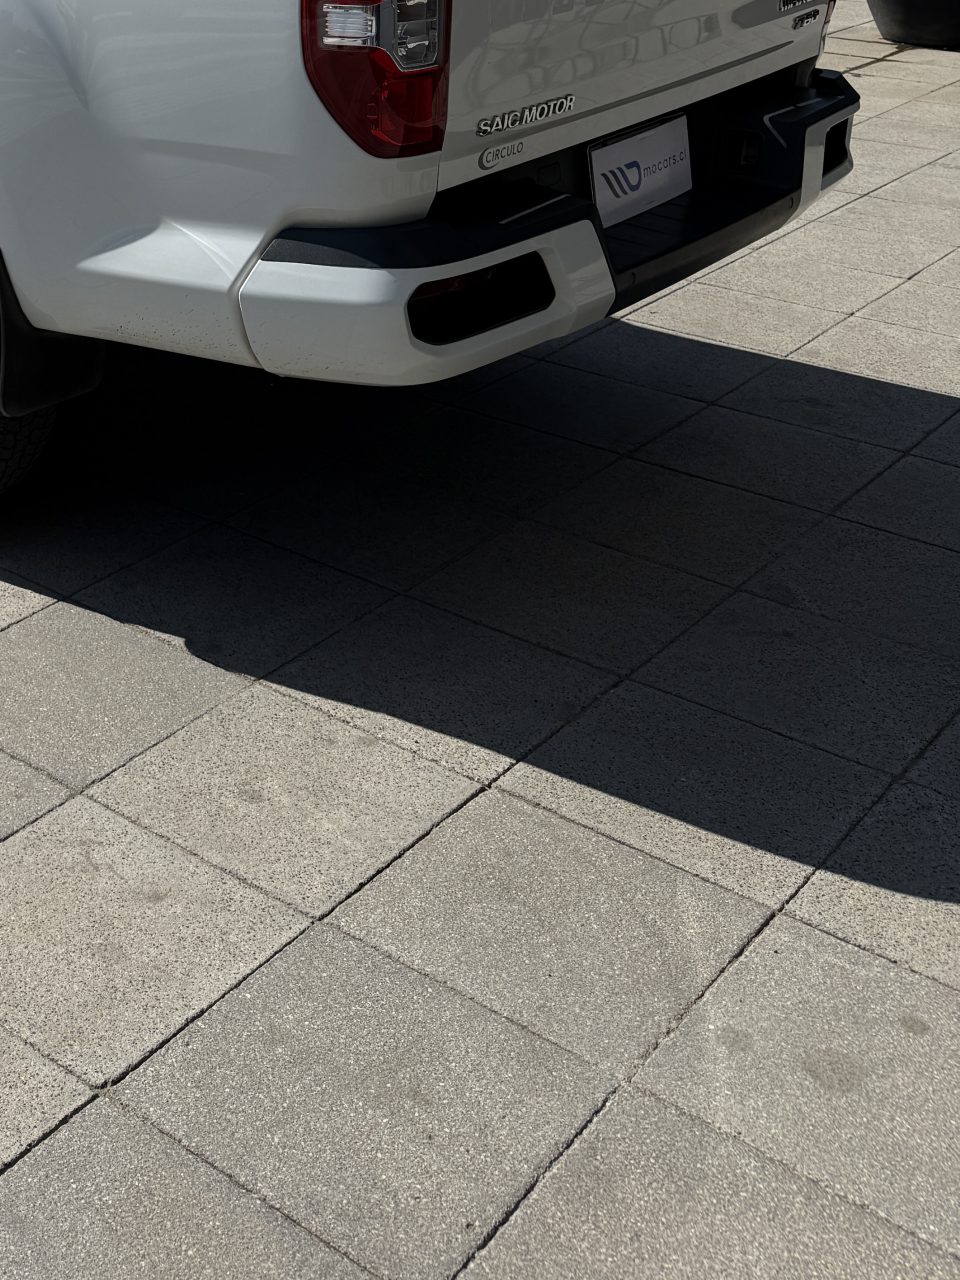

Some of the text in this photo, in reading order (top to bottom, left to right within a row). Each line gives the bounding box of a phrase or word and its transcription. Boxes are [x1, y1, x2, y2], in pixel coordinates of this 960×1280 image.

[476, 93, 576, 137] SAIC MOTOR
[643, 148, 687, 179] mocars.cl
